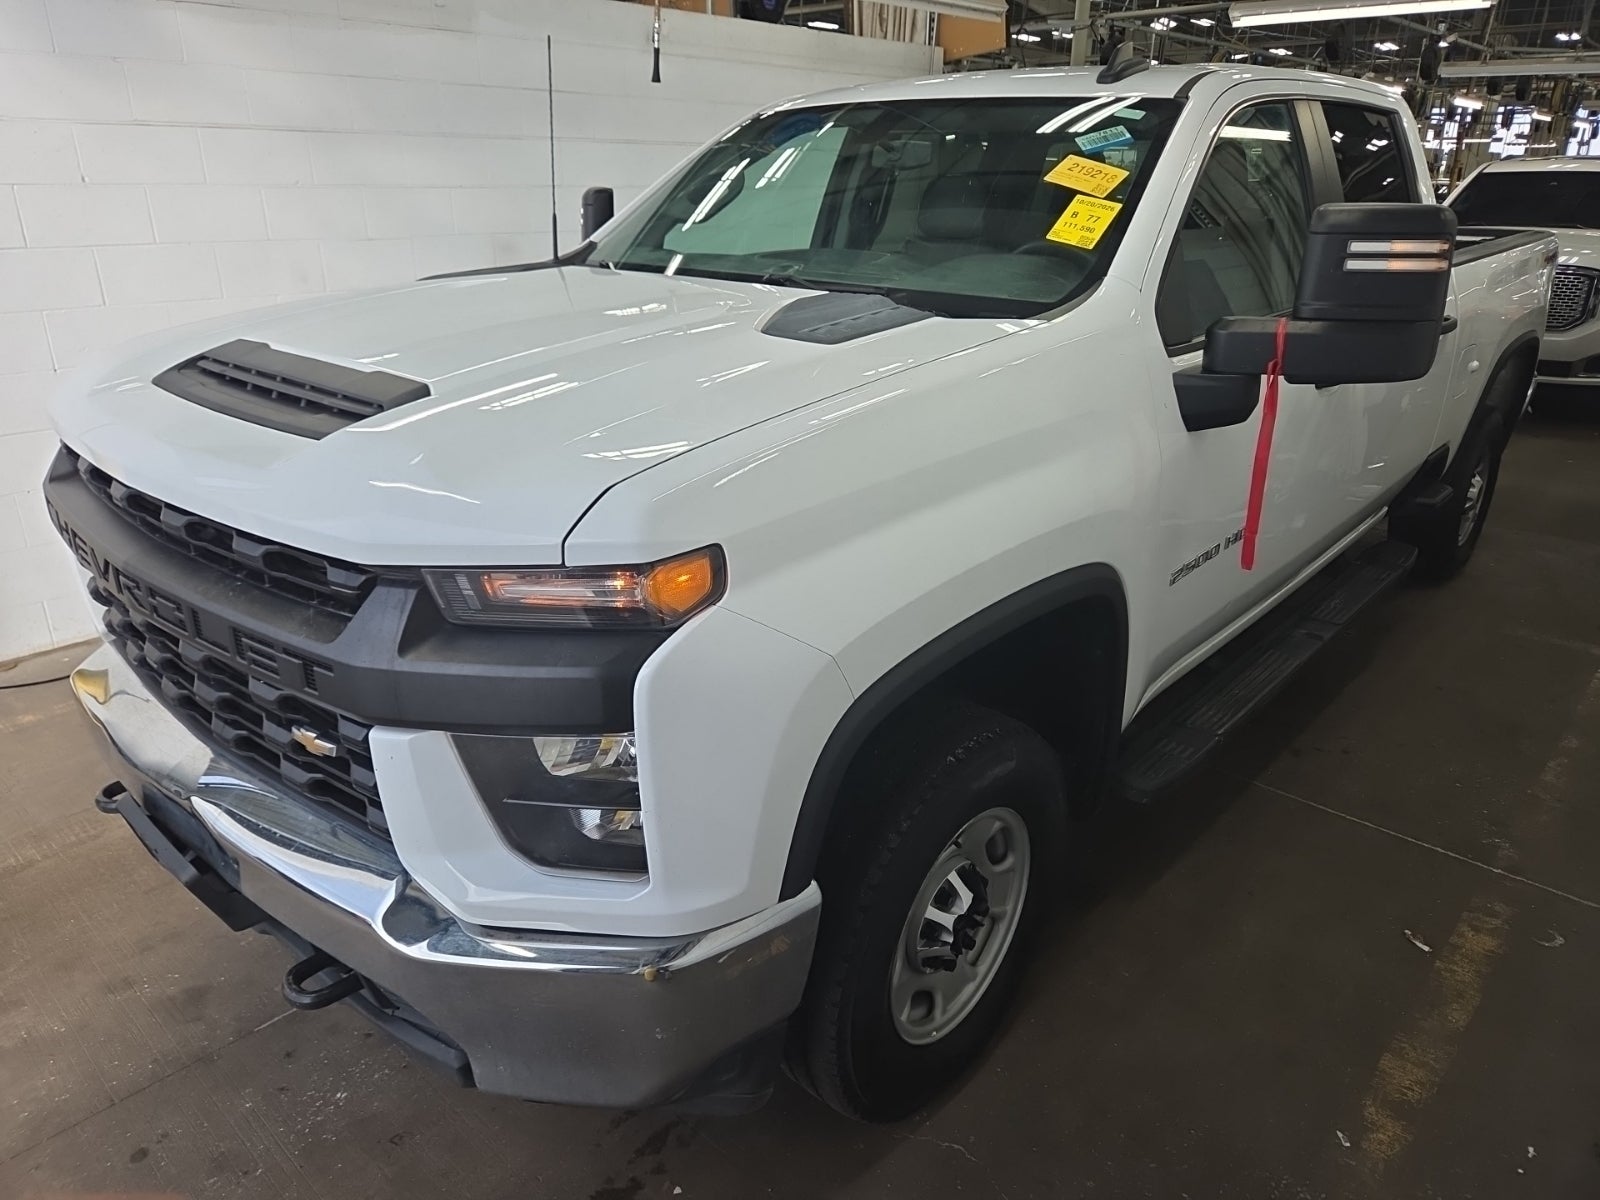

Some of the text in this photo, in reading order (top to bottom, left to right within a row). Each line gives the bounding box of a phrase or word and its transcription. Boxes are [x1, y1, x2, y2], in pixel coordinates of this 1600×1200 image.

[1067, 162, 1118, 183] 219218
[1070, 210, 1101, 223] B 77
[1169, 528, 1246, 586] 2500 H
[47, 498, 335, 695] CHEVROLET
